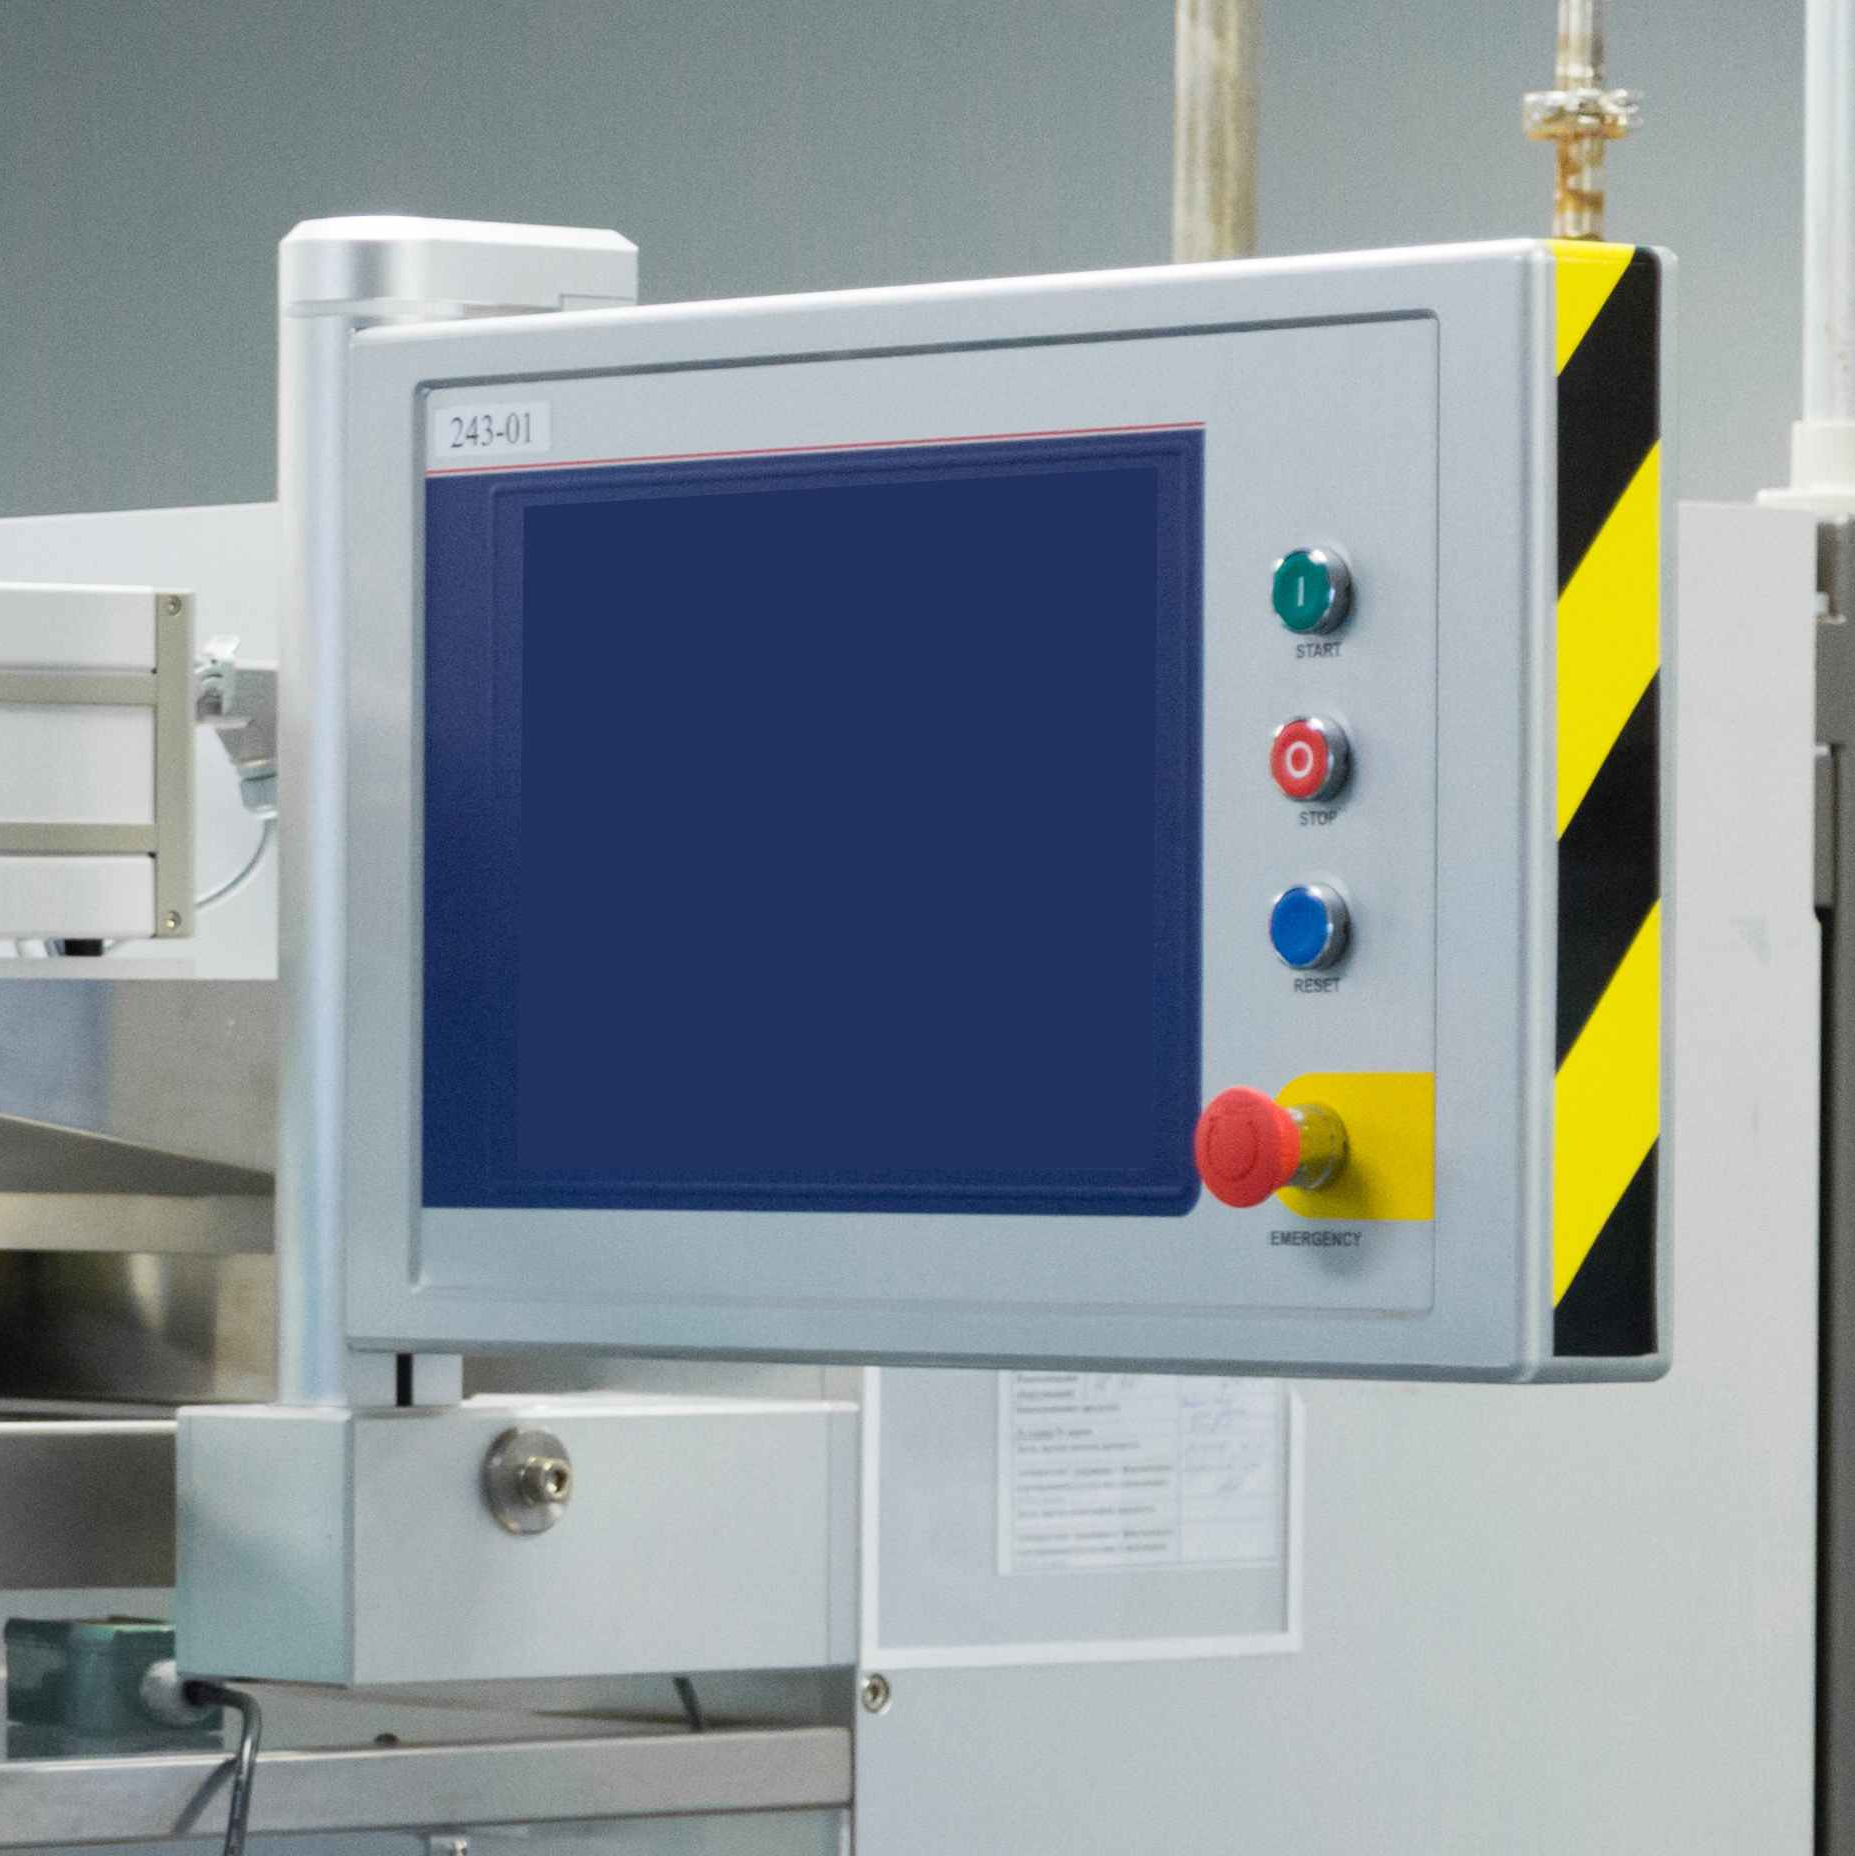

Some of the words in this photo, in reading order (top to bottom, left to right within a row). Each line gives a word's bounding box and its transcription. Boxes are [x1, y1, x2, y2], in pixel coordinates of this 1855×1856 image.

[450, 412, 531, 448] 243-01
[1297, 641, 1342, 658] START
[1299, 810, 1337, 826] STOP
[1294, 977, 1340, 993] RESET
[1270, 1230, 1362, 1246] EMERGENCY
